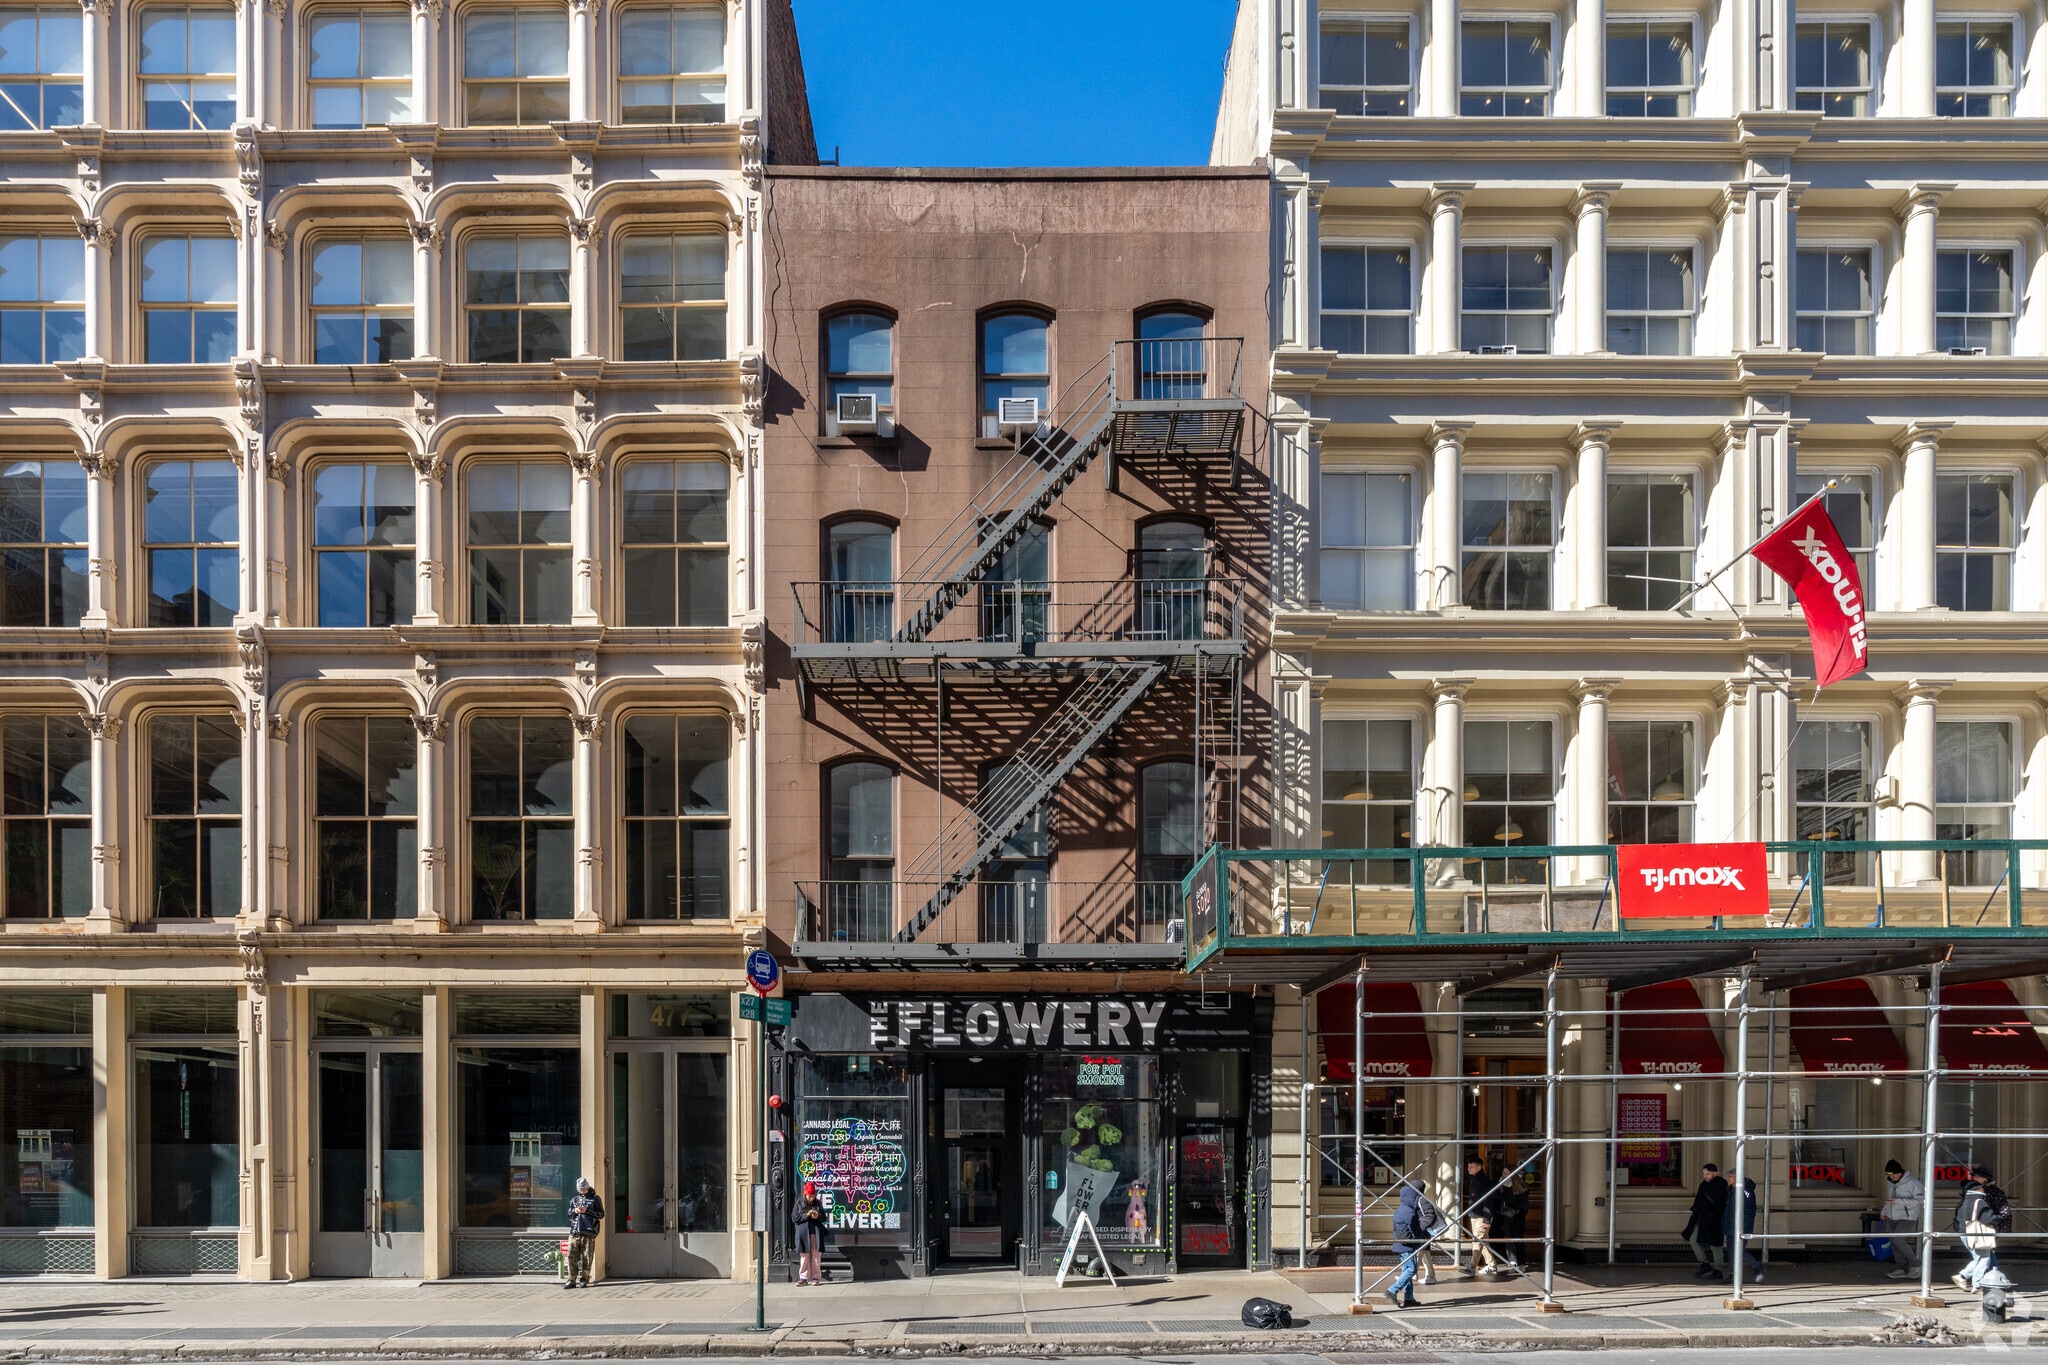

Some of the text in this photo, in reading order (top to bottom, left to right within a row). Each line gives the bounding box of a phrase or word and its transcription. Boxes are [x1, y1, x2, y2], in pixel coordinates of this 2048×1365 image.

[650, 1005, 690, 1027] 477
[870, 1001, 1167, 1046] THE FLOWERY
[1080, 1064, 1122, 1075] FOR POT
[1077, 1074, 1125, 1086] SMOKING
[802, 1120, 831, 1129] CANNABIS
[856, 1119, 901, 1131] 合法大麻
[803, 1174, 850, 1182] Yasal Esrar
[825, 1212, 882, 1229] LIVER
